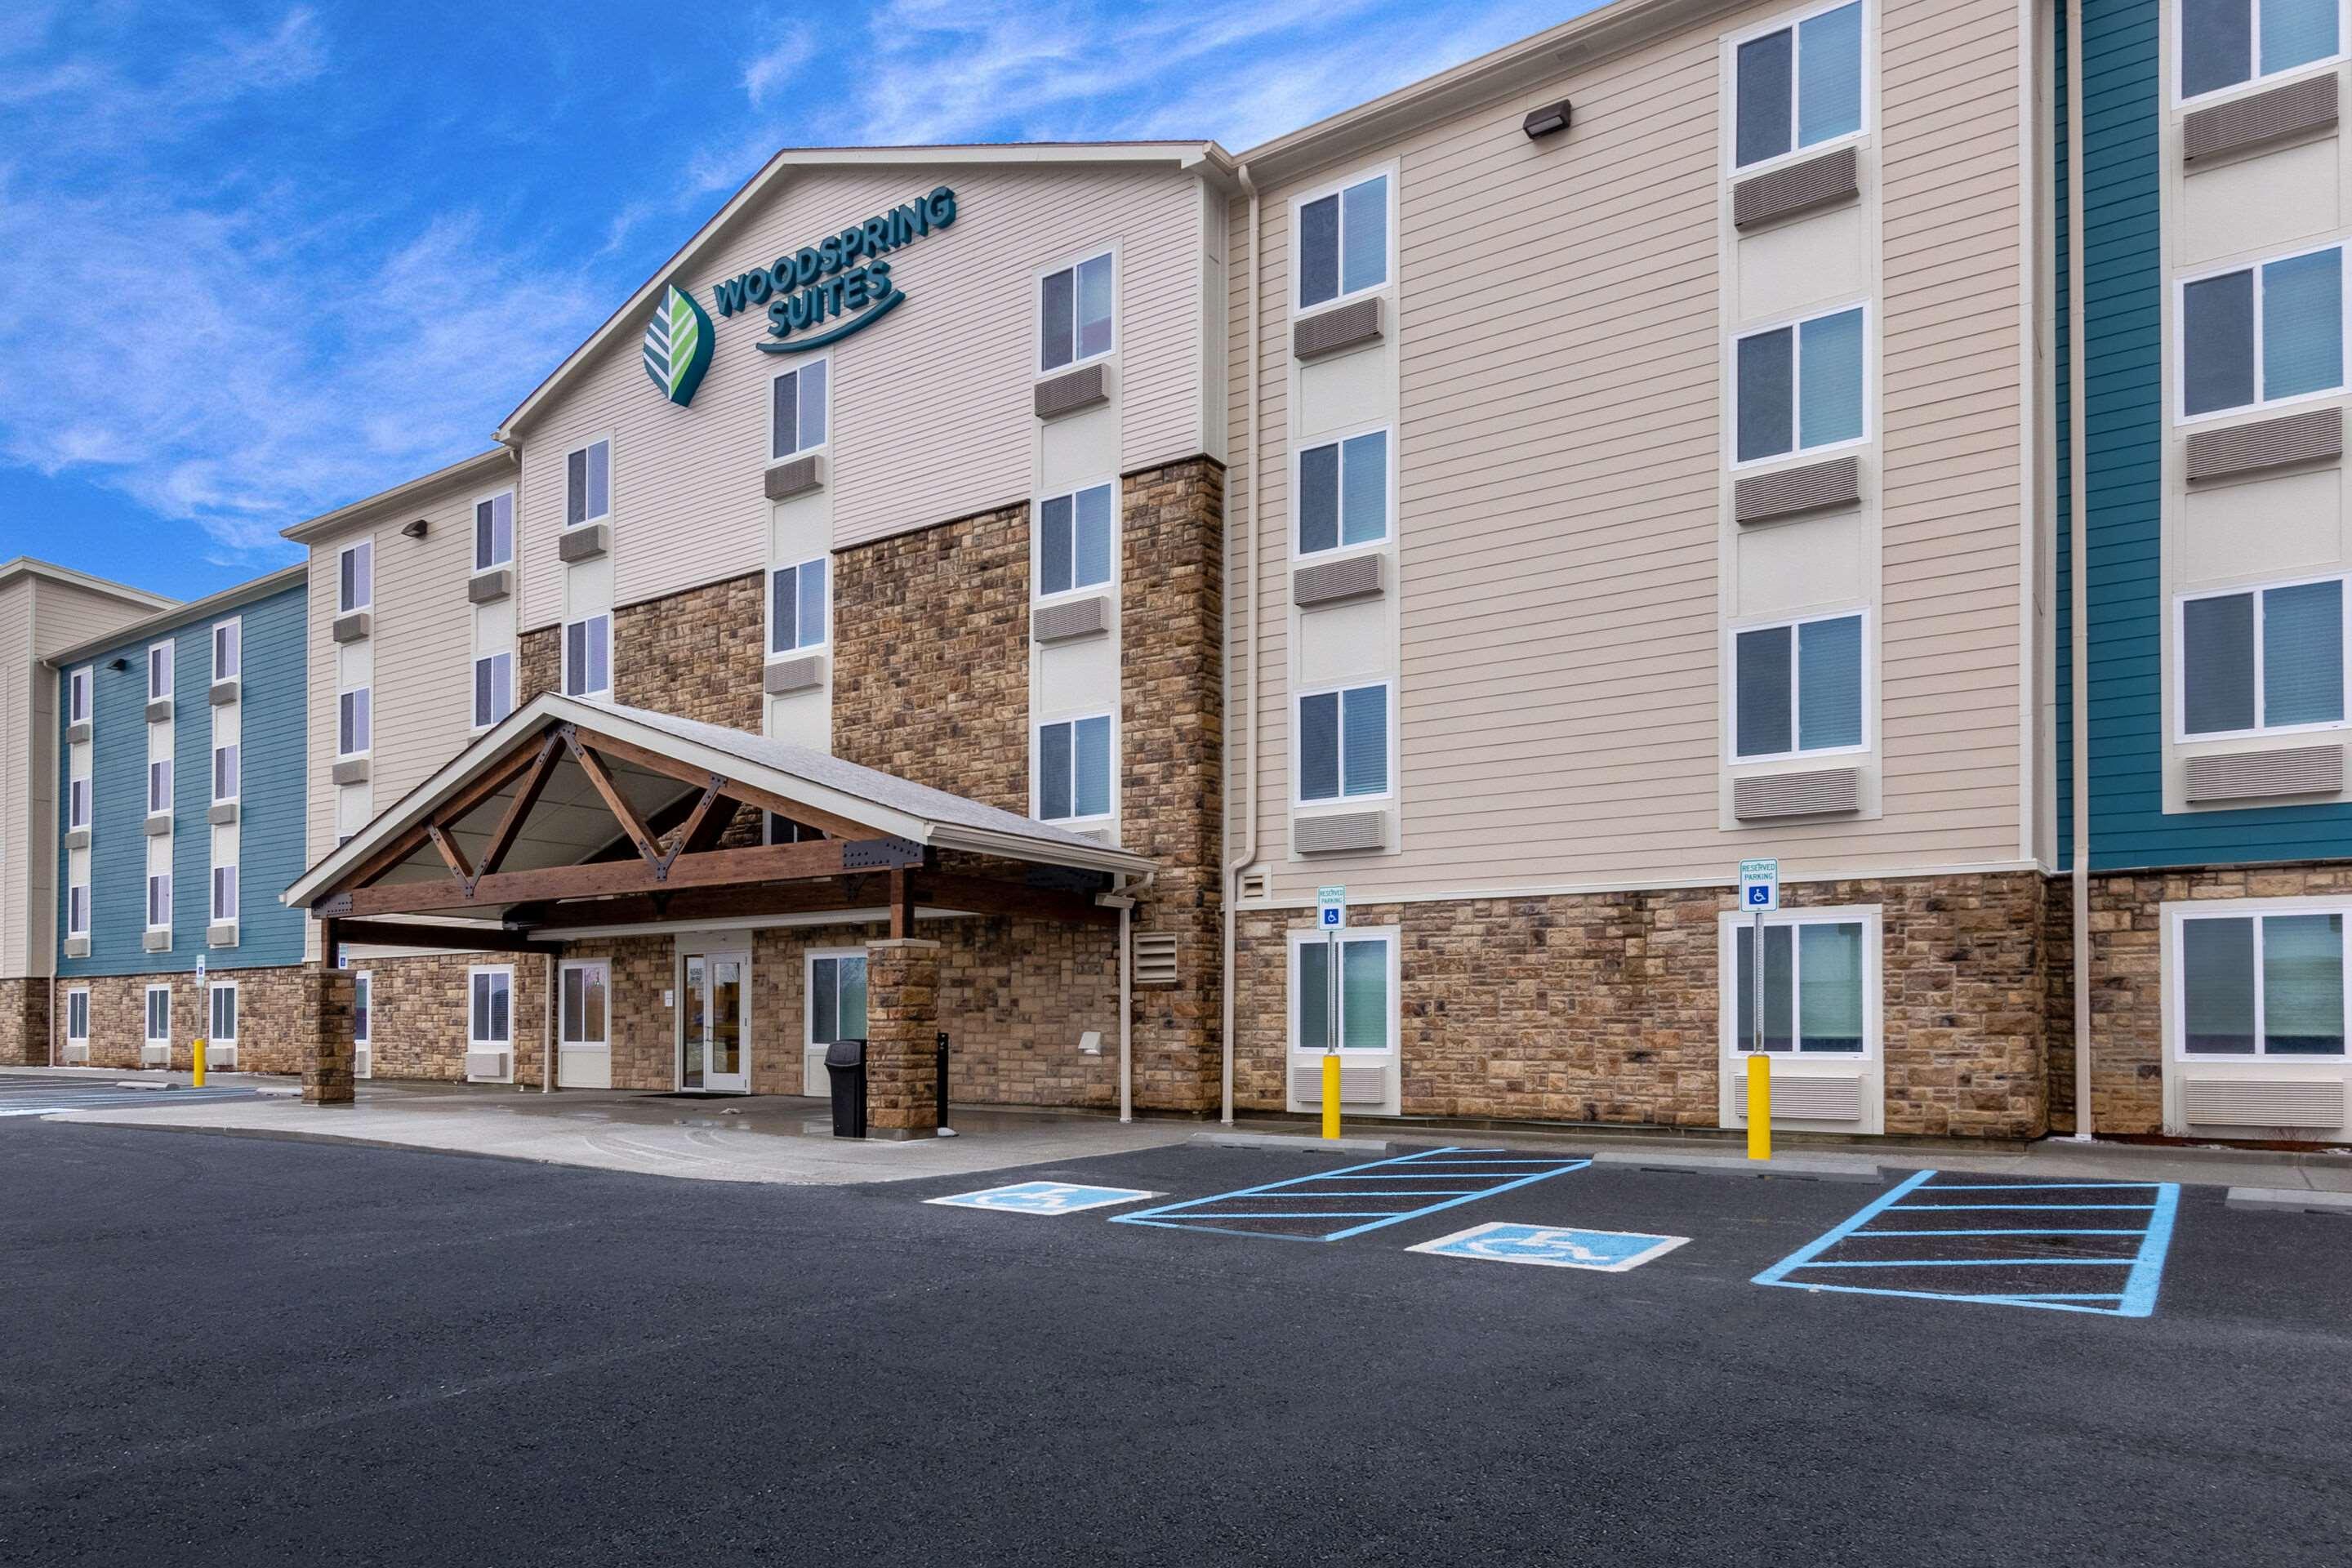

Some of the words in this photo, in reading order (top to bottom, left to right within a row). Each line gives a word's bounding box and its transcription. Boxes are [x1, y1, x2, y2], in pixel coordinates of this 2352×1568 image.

[713, 185, 956, 318] WOODSPRING
[768, 261, 892, 338] SUITES
[1742, 863, 1775, 872] RESERVED
[1744, 873, 1773, 881] PARKING
